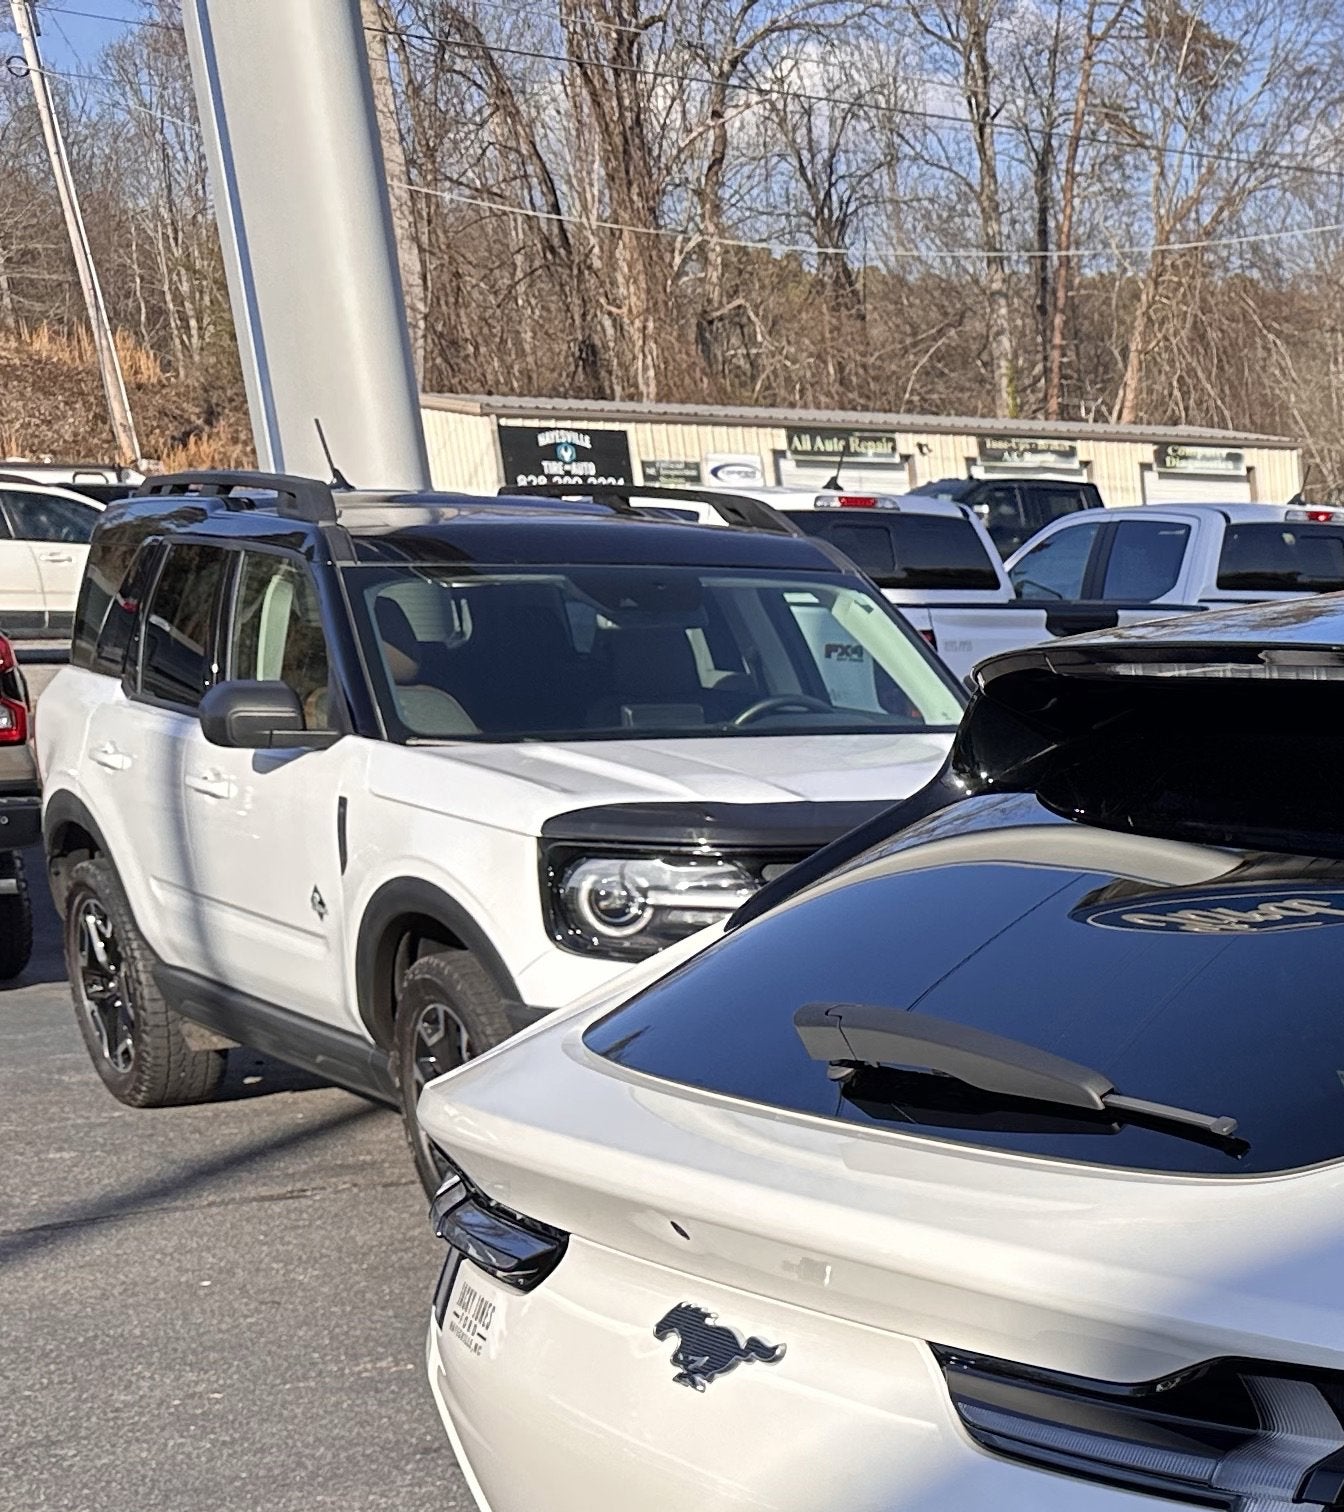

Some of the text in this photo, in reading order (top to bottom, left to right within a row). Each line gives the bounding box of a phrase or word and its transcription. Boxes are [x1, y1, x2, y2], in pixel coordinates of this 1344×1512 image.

[790, 433, 894, 455] All Auto Repair
[541, 460, 565, 475] TIRE
[456, 1281, 496, 1331] JACKY JONES
